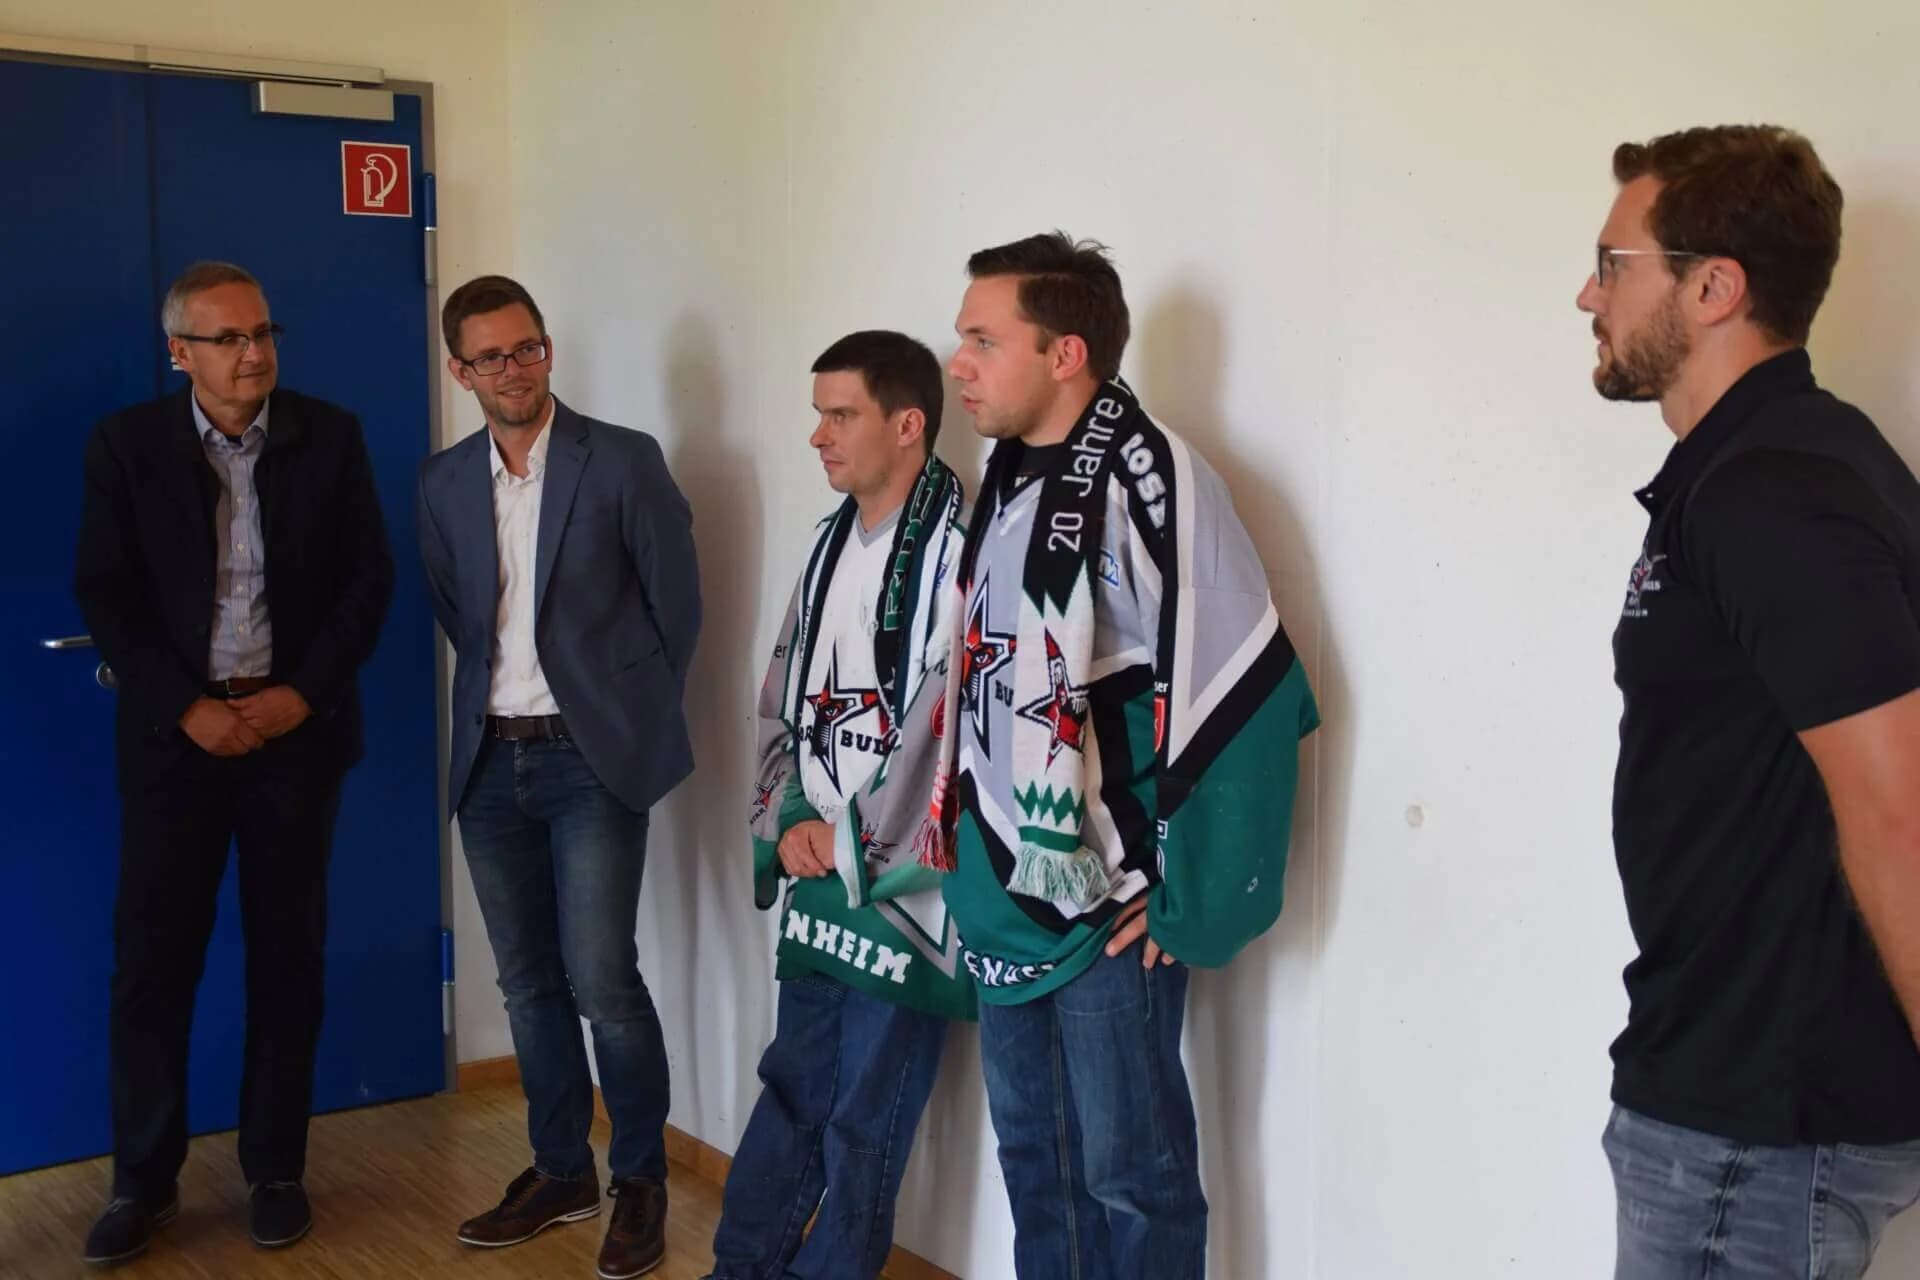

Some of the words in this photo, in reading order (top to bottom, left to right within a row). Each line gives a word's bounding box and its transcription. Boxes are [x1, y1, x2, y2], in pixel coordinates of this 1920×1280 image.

[1062, 398, 1124, 497] Jahre
[1047, 511, 1084, 552] 20
[785, 908, 913, 984] NHEIM
